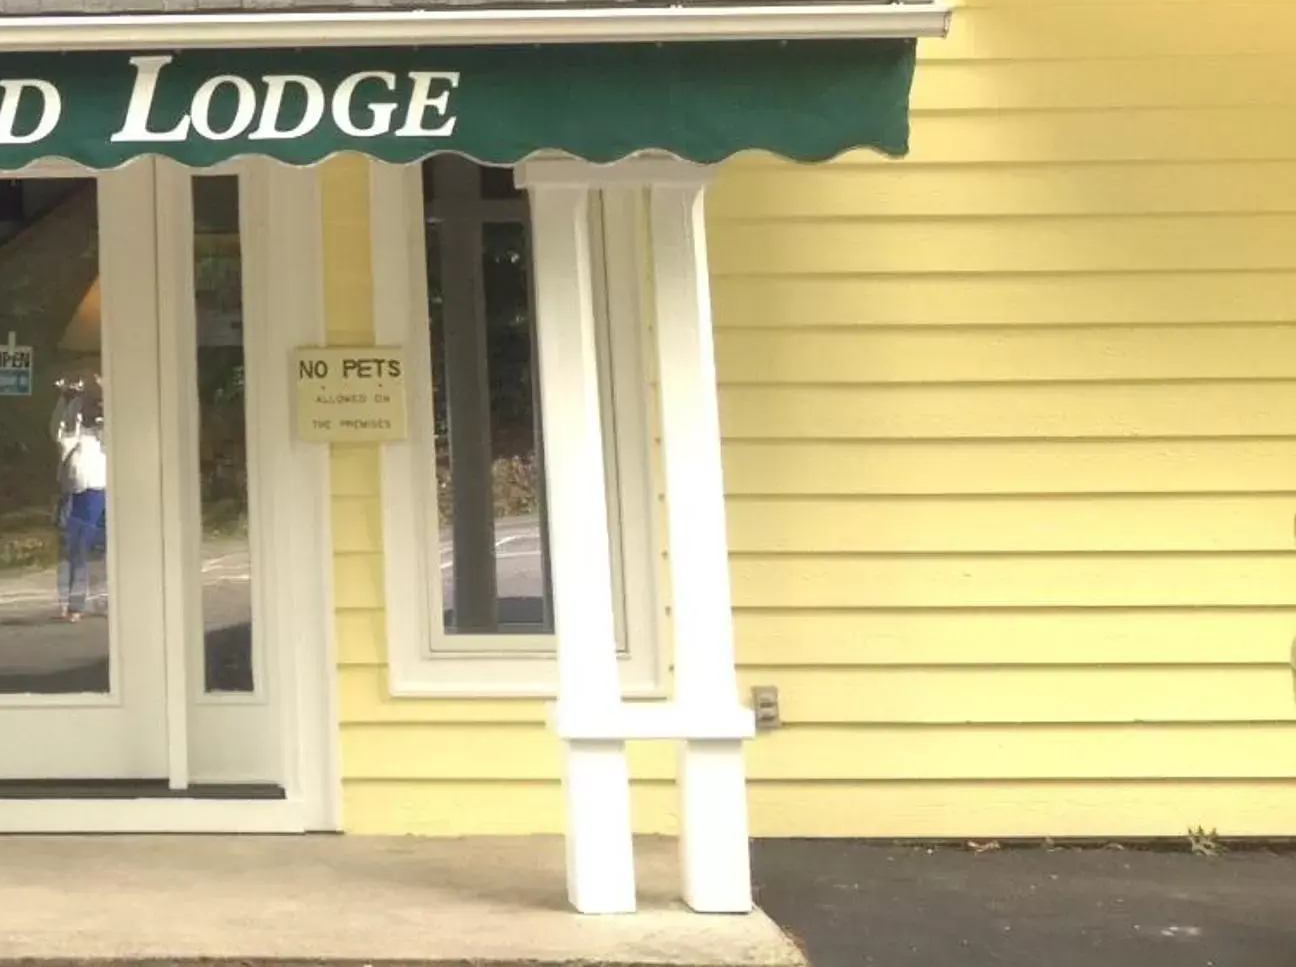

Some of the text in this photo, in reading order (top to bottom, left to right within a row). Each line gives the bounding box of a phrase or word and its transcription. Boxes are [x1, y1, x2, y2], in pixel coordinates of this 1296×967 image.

[111, 55, 459, 142] LODGE
[298, 358, 401, 379] NO PETS
[315, 393, 367, 404] ALLOWED
